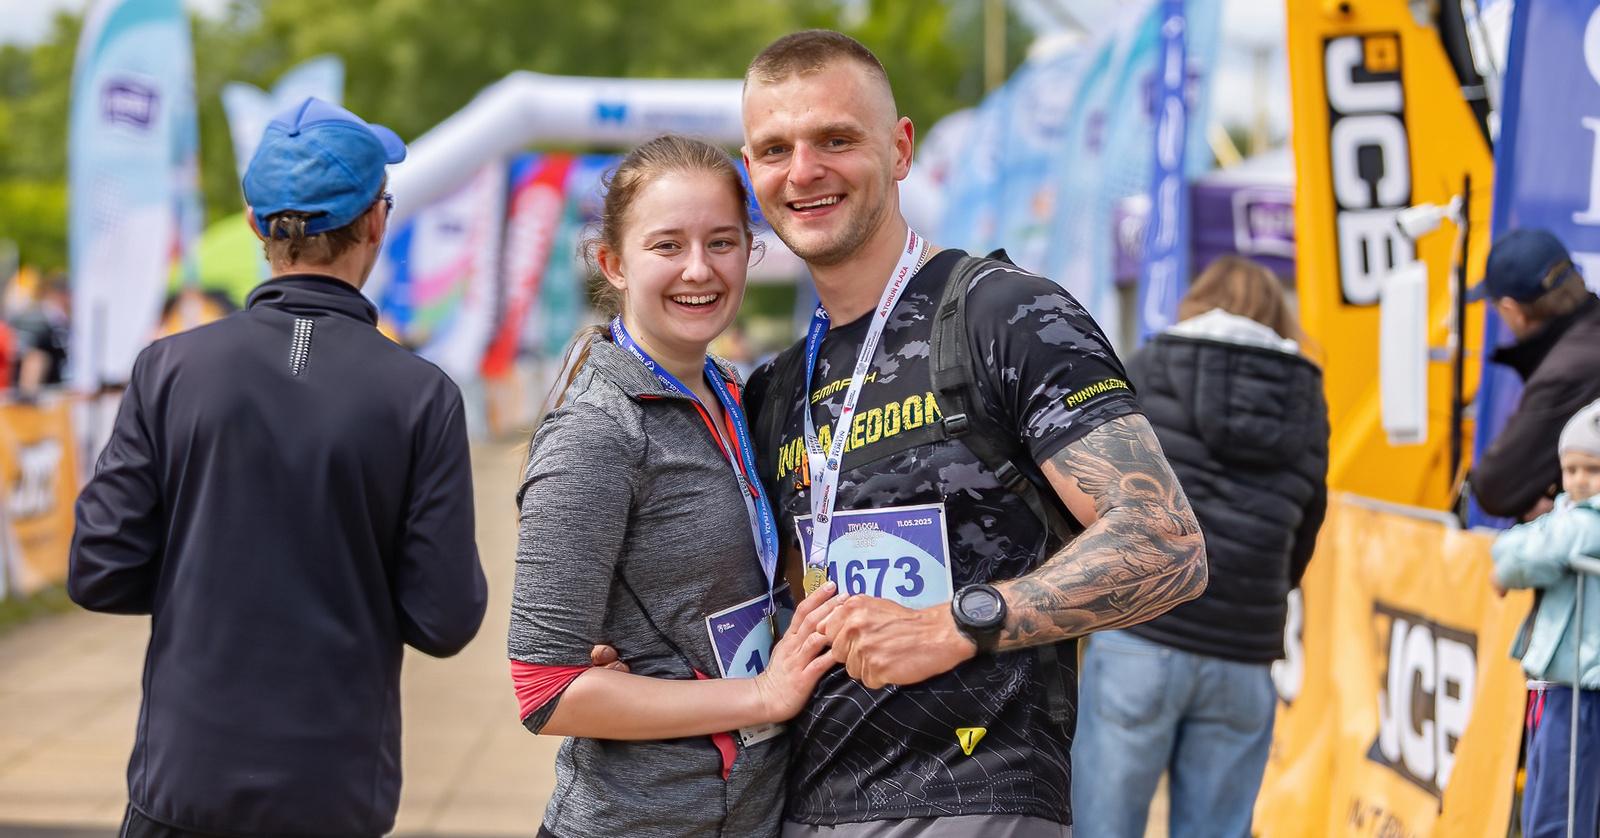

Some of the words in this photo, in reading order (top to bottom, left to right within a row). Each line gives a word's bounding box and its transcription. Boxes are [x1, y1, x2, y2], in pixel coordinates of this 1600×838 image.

[1325, 36, 1416, 306] JCB
[895, 266, 908, 288] PLAZA
[811, 371, 877, 404] SMMAH
[897, 517, 933, 527] 11.05.2025
[828, 556, 925, 597] 1673
[1377, 617, 1478, 791] JCB
